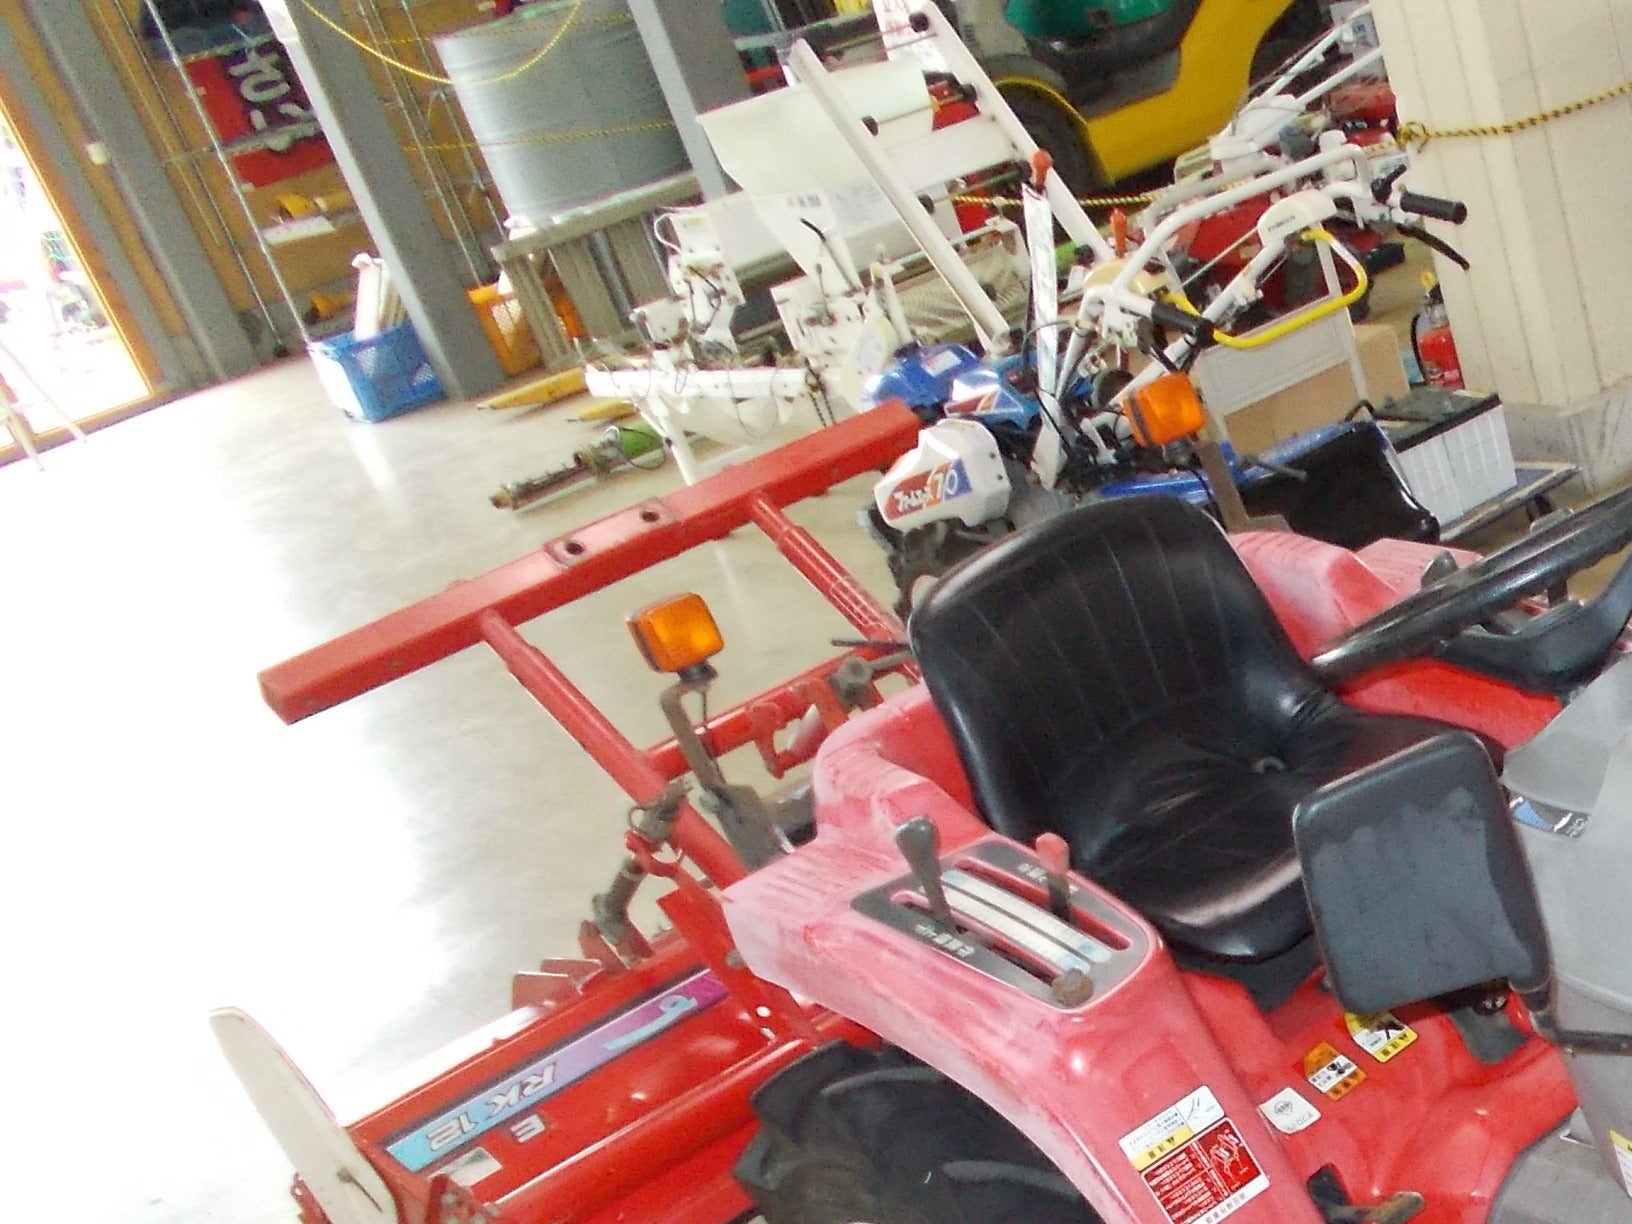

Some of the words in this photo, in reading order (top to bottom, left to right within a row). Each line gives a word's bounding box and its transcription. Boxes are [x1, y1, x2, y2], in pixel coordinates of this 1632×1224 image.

[485, 1062, 556, 1121] RK
[426, 1112, 479, 1151] 12
[510, 1114, 546, 1144] E
